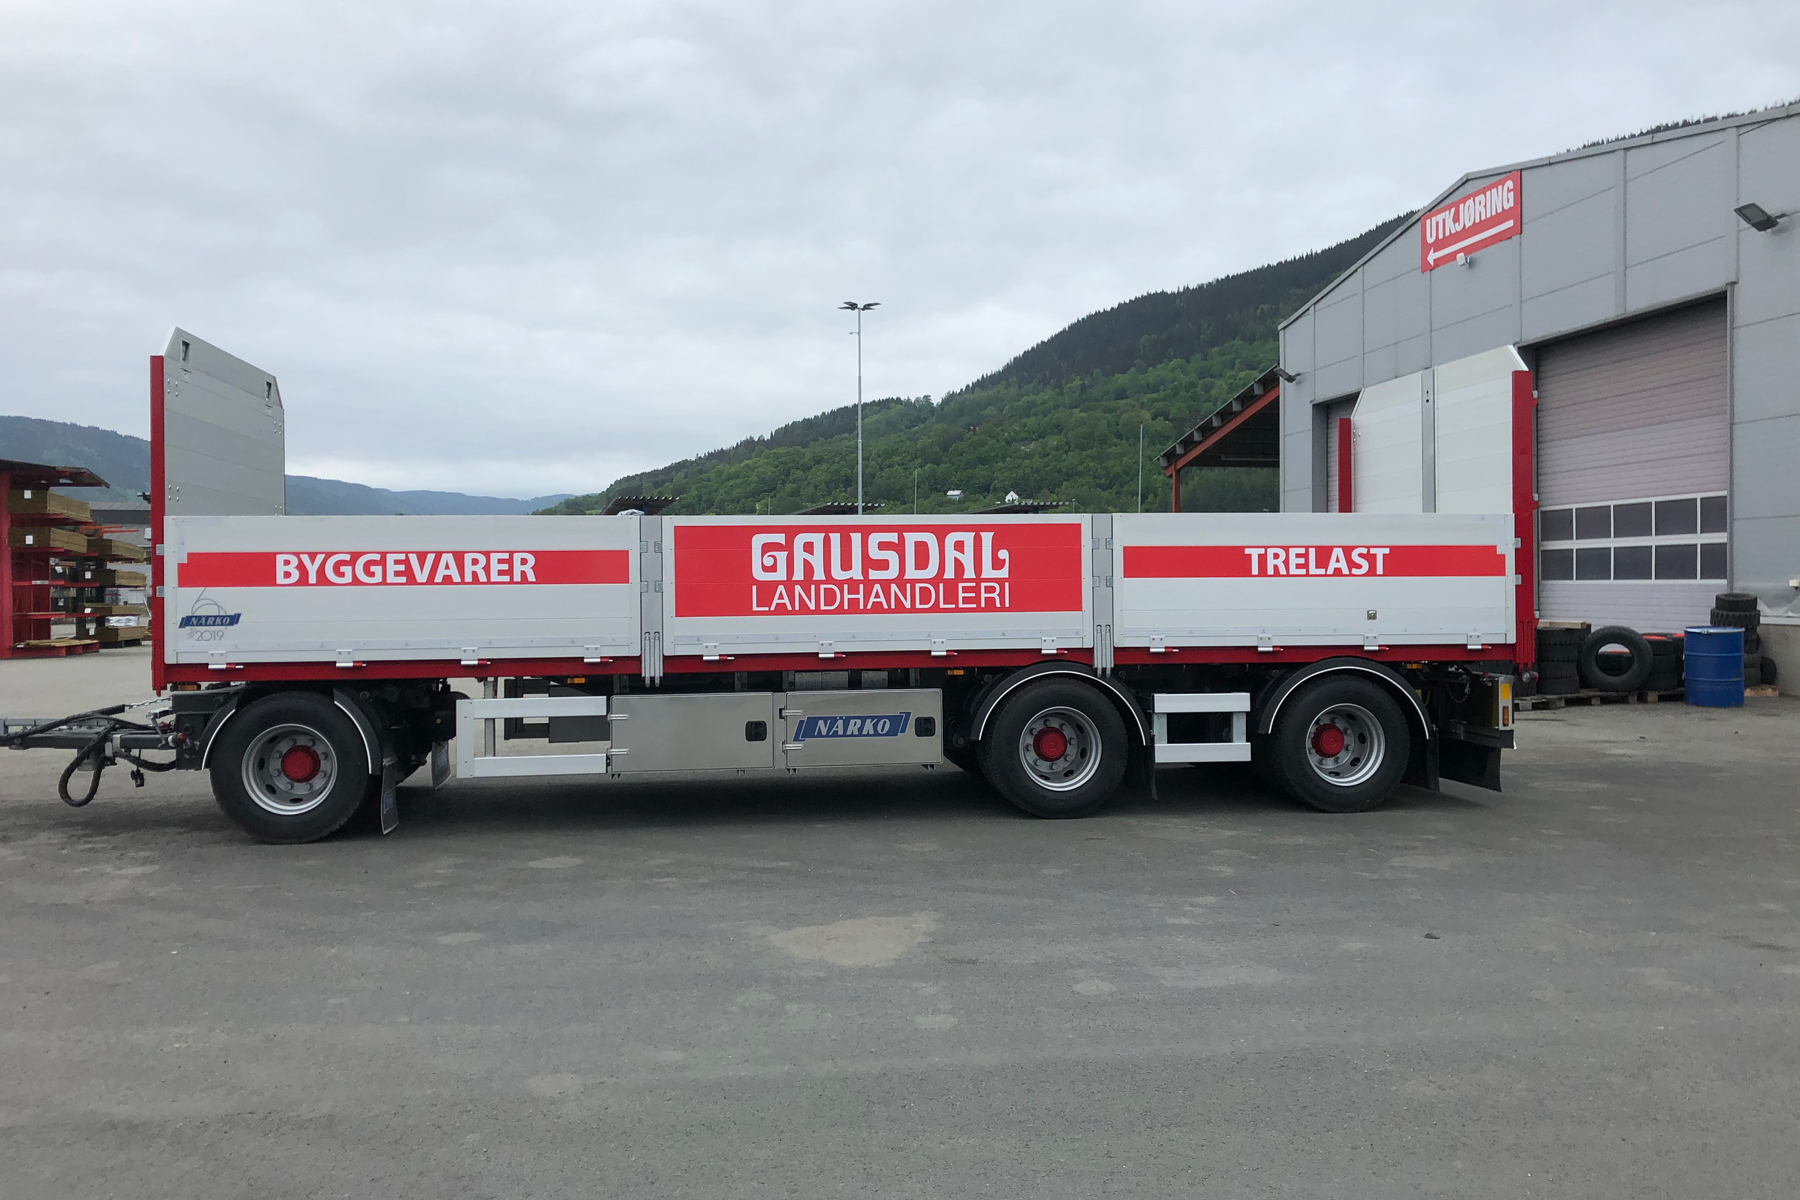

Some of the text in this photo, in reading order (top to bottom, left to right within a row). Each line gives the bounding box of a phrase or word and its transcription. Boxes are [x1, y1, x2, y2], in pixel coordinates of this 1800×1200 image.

[1426, 180, 1514, 244] UTKJØRING
[275, 553, 536, 584] BYGGEVARER
[752, 532, 1009, 581] GAUSDAL
[1245, 547, 1390, 575] TRELAST
[752, 582, 1010, 611] LANDHANDLERI
[196, 630, 224, 641] 2019
[814, 717, 891, 736] NÄRKO
